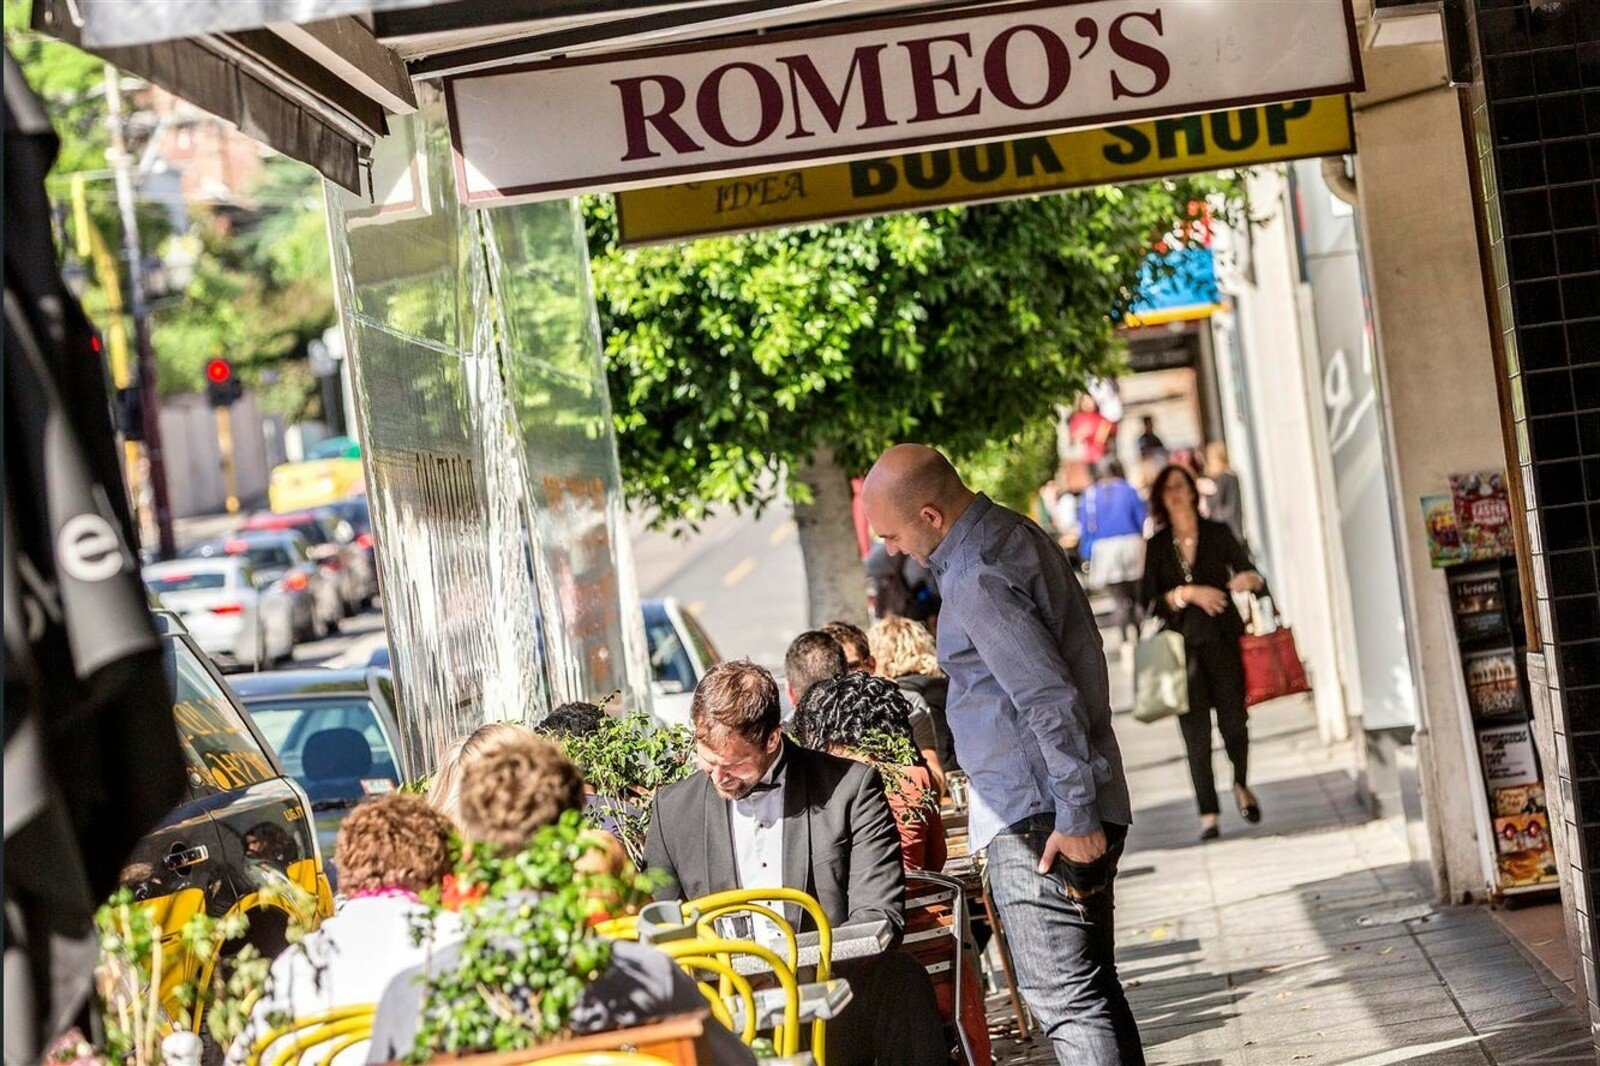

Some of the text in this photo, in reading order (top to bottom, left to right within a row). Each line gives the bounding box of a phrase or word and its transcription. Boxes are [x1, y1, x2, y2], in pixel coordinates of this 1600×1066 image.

[609, 8, 1171, 162] ROMEO'S
[714, 170, 807, 213] IDEA
[850, 99, 1312, 198] BOOK SHOP
